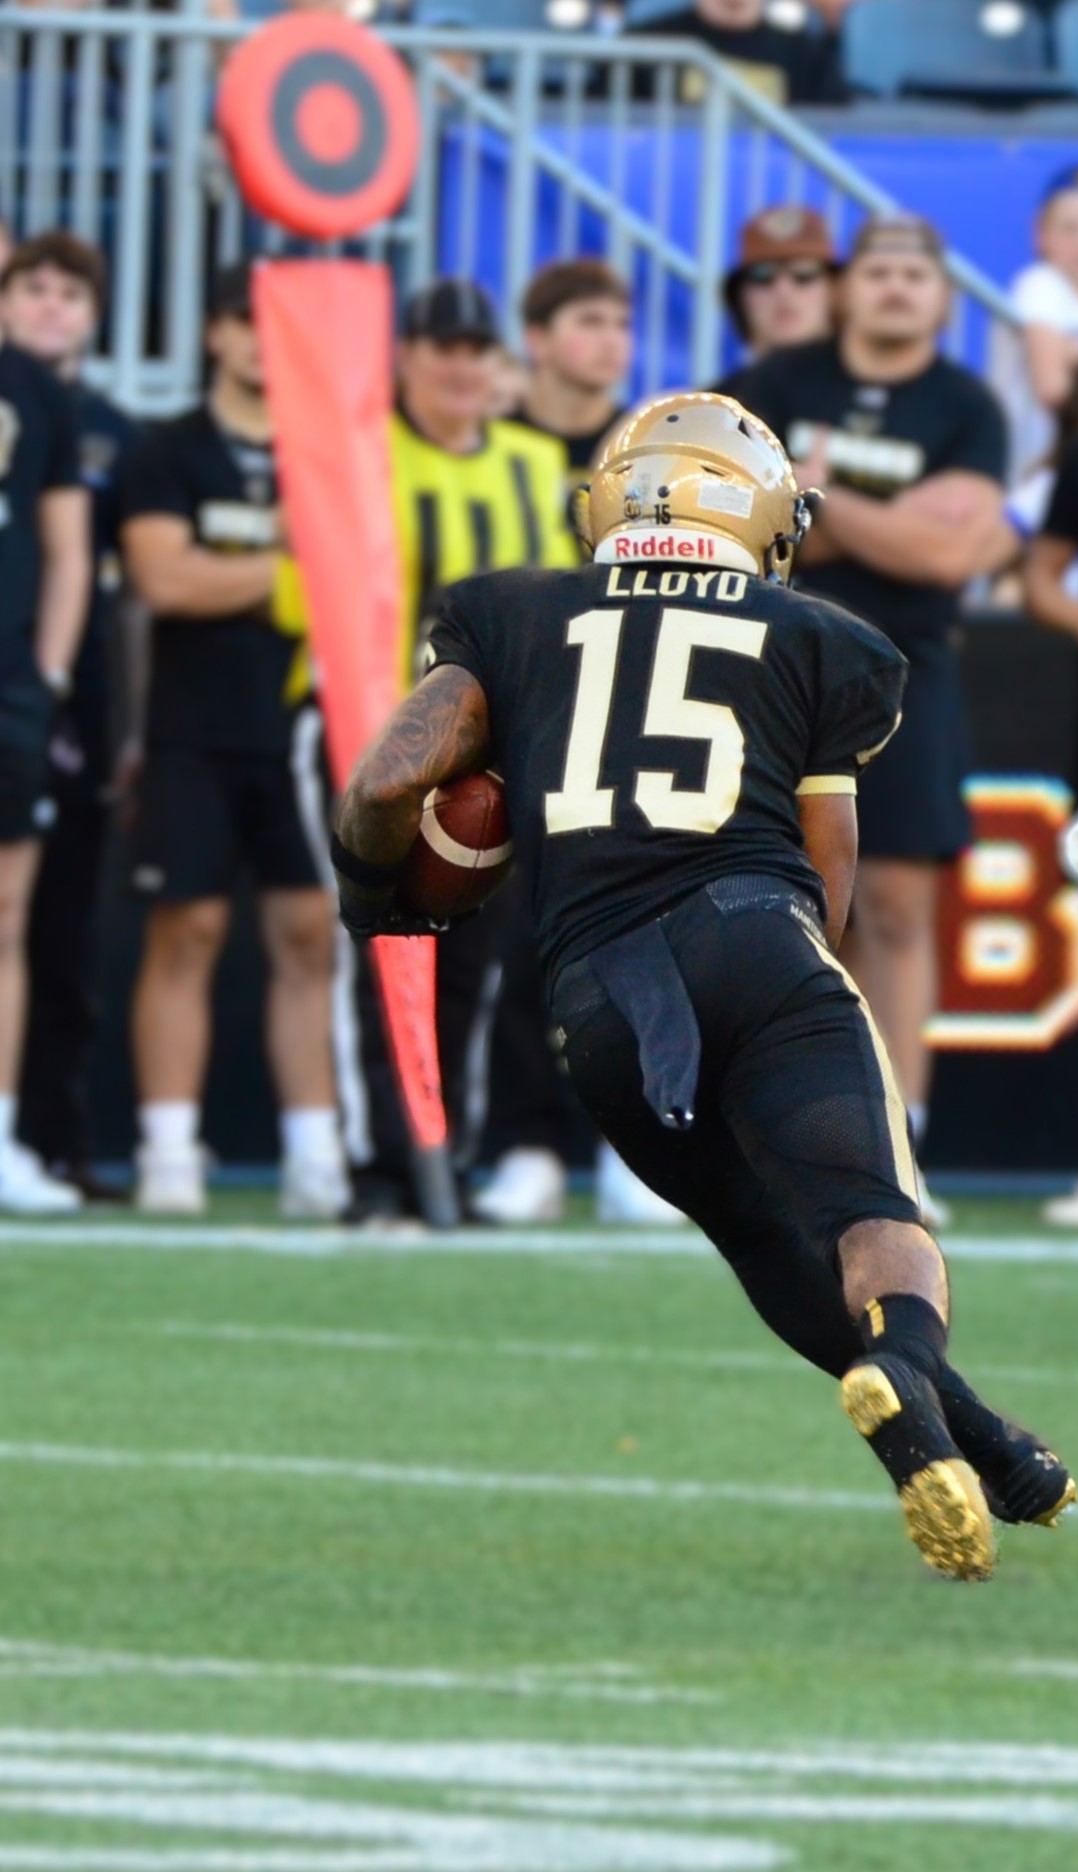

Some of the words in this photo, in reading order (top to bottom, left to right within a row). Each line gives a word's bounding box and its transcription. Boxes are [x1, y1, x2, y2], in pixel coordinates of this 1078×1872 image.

[654, 504, 672, 526] 15
[615, 536, 715, 560] Riddell
[606, 565, 749, 602] LLOYD
[545, 608, 768, 835] 15
